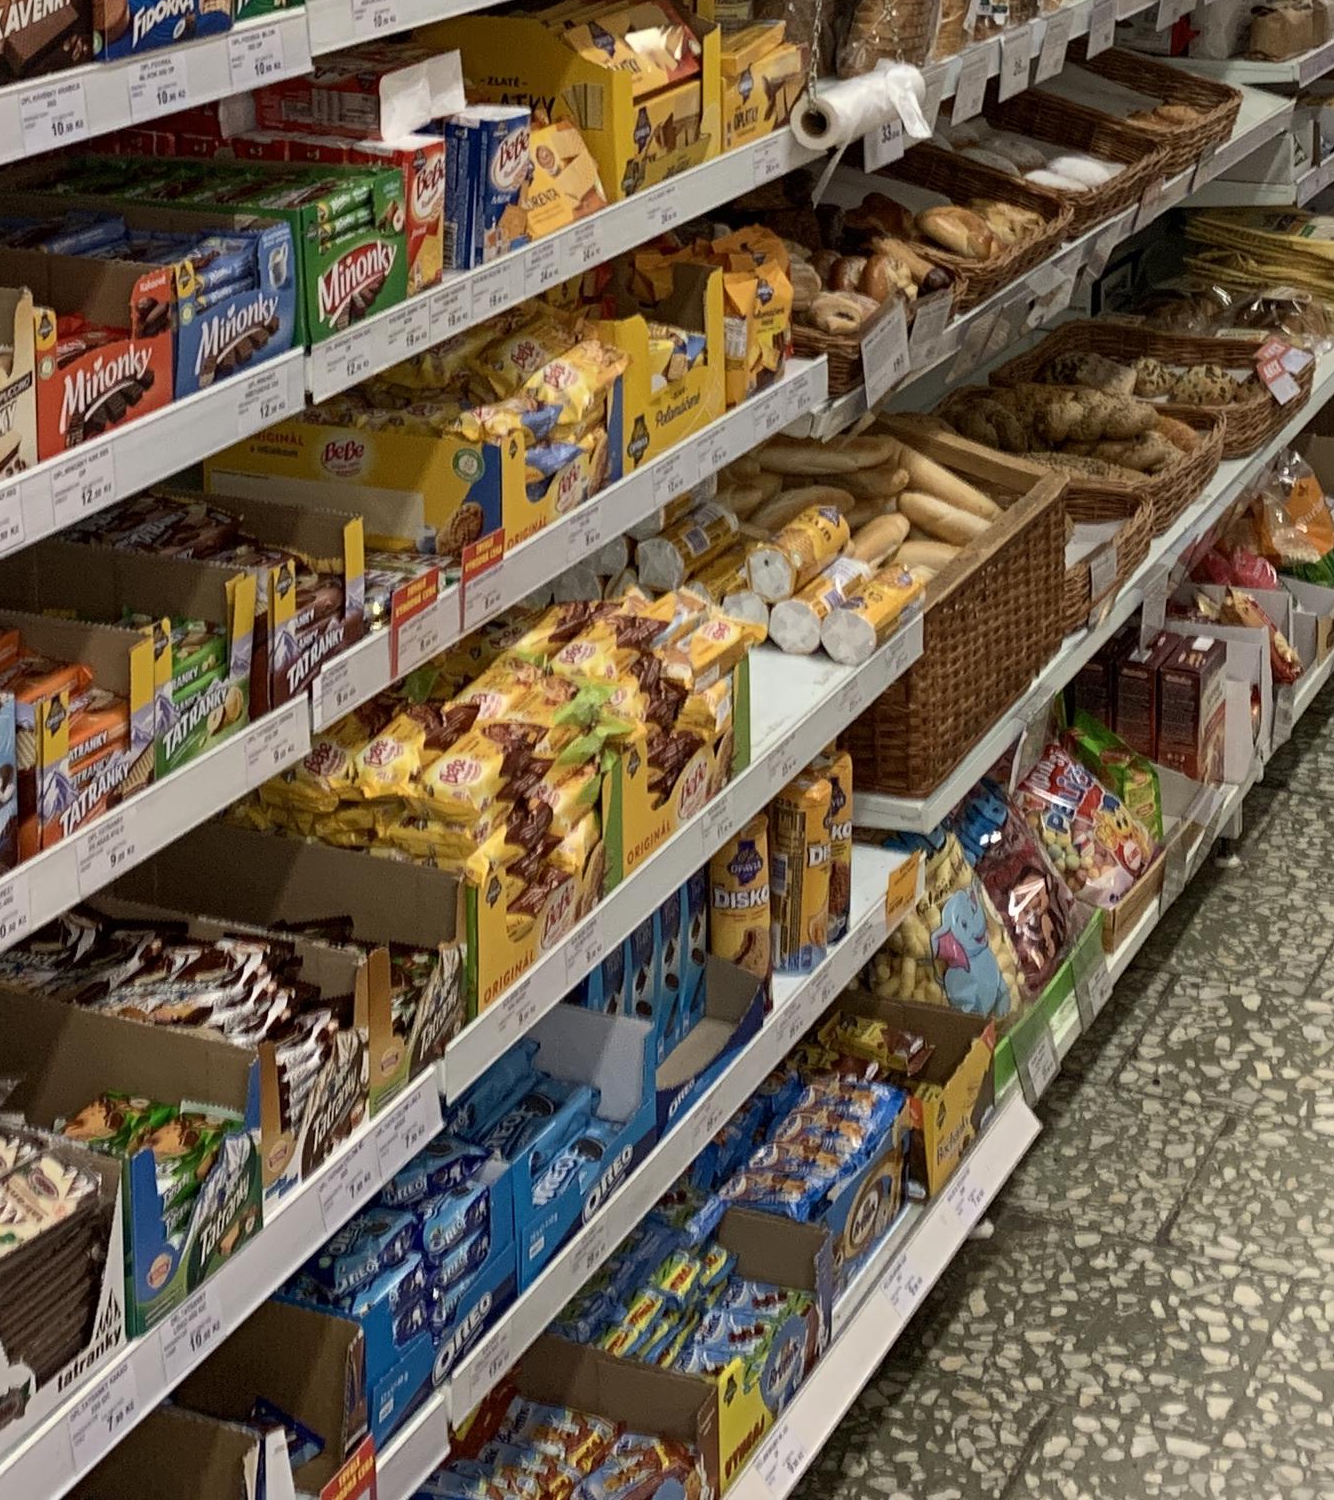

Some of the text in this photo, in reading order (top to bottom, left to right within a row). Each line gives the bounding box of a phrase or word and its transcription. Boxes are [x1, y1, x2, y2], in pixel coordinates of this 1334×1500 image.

[323, 438, 366, 464] BeBe
[288, 624, 345, 692] TATRANKY
[163, 685, 229, 760] TATRANKY
[59, 760, 131, 836] TATRANKY
[581, 1143, 636, 1226] OREO
[55, 1324, 124, 1393] tatranky
[432, 1291, 493, 1387] OREO
